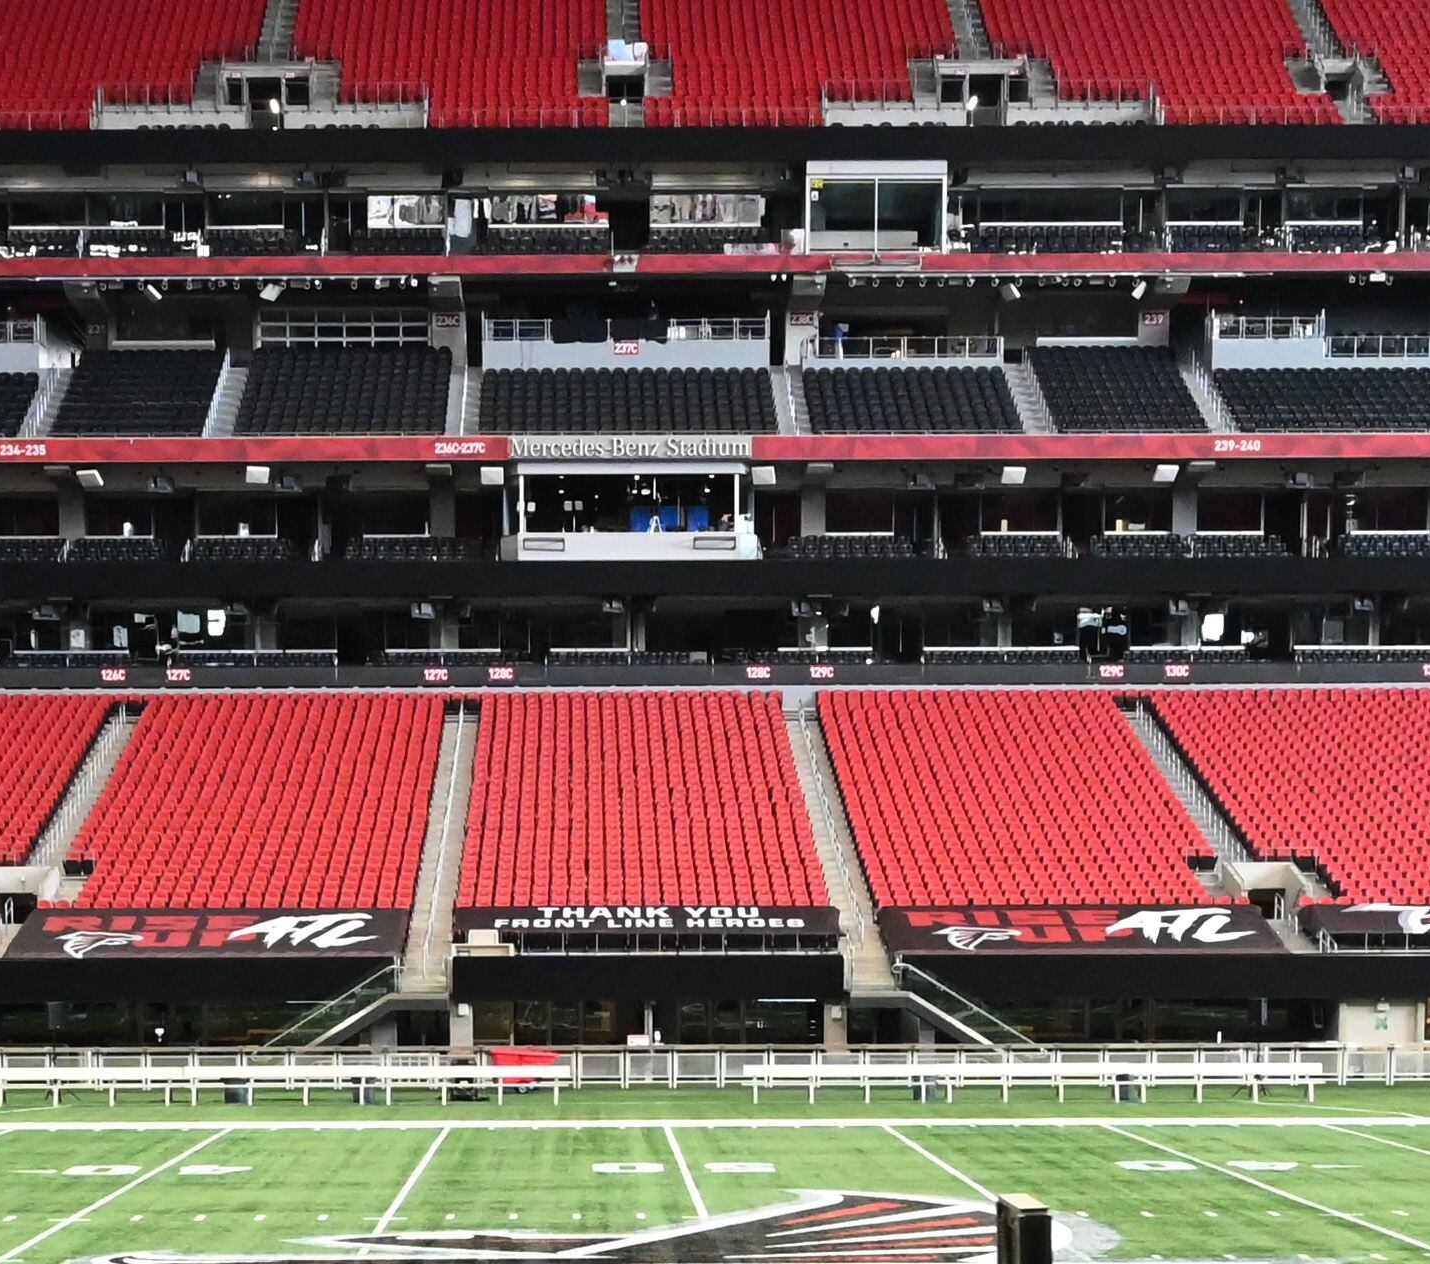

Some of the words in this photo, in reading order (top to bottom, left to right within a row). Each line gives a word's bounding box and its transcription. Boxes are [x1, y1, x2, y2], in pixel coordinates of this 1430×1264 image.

[437, 315, 459, 326] 236C
[1144, 314, 1164, 324] 239
[614, 343, 638, 354] 237C
[0, 444, 47, 456] 234-235
[435, 442, 486, 454] 236C-237C
[511, 438, 658, 457] Mercedes-Benz
[667, 438, 750, 457] Stadium
[1214, 440, 1261, 452] 239-240
[101, 669, 126, 681] 126C
[166, 669, 191, 681] 127C
[424, 669, 448, 681] 127C
[489, 668, 513, 679] 128C
[746, 667, 770, 678] 128C
[810, 666, 834, 678] 129C
[1100, 665, 1124, 677] 129C
[1165, 665, 1189, 677] 130C
[537, 907, 670, 918] THANK
[684, 907, 758, 918] YOU
[495, 918, 590, 928] FRONT
[607, 918, 674, 928] LINE
[687, 918, 805, 928] HEROES
